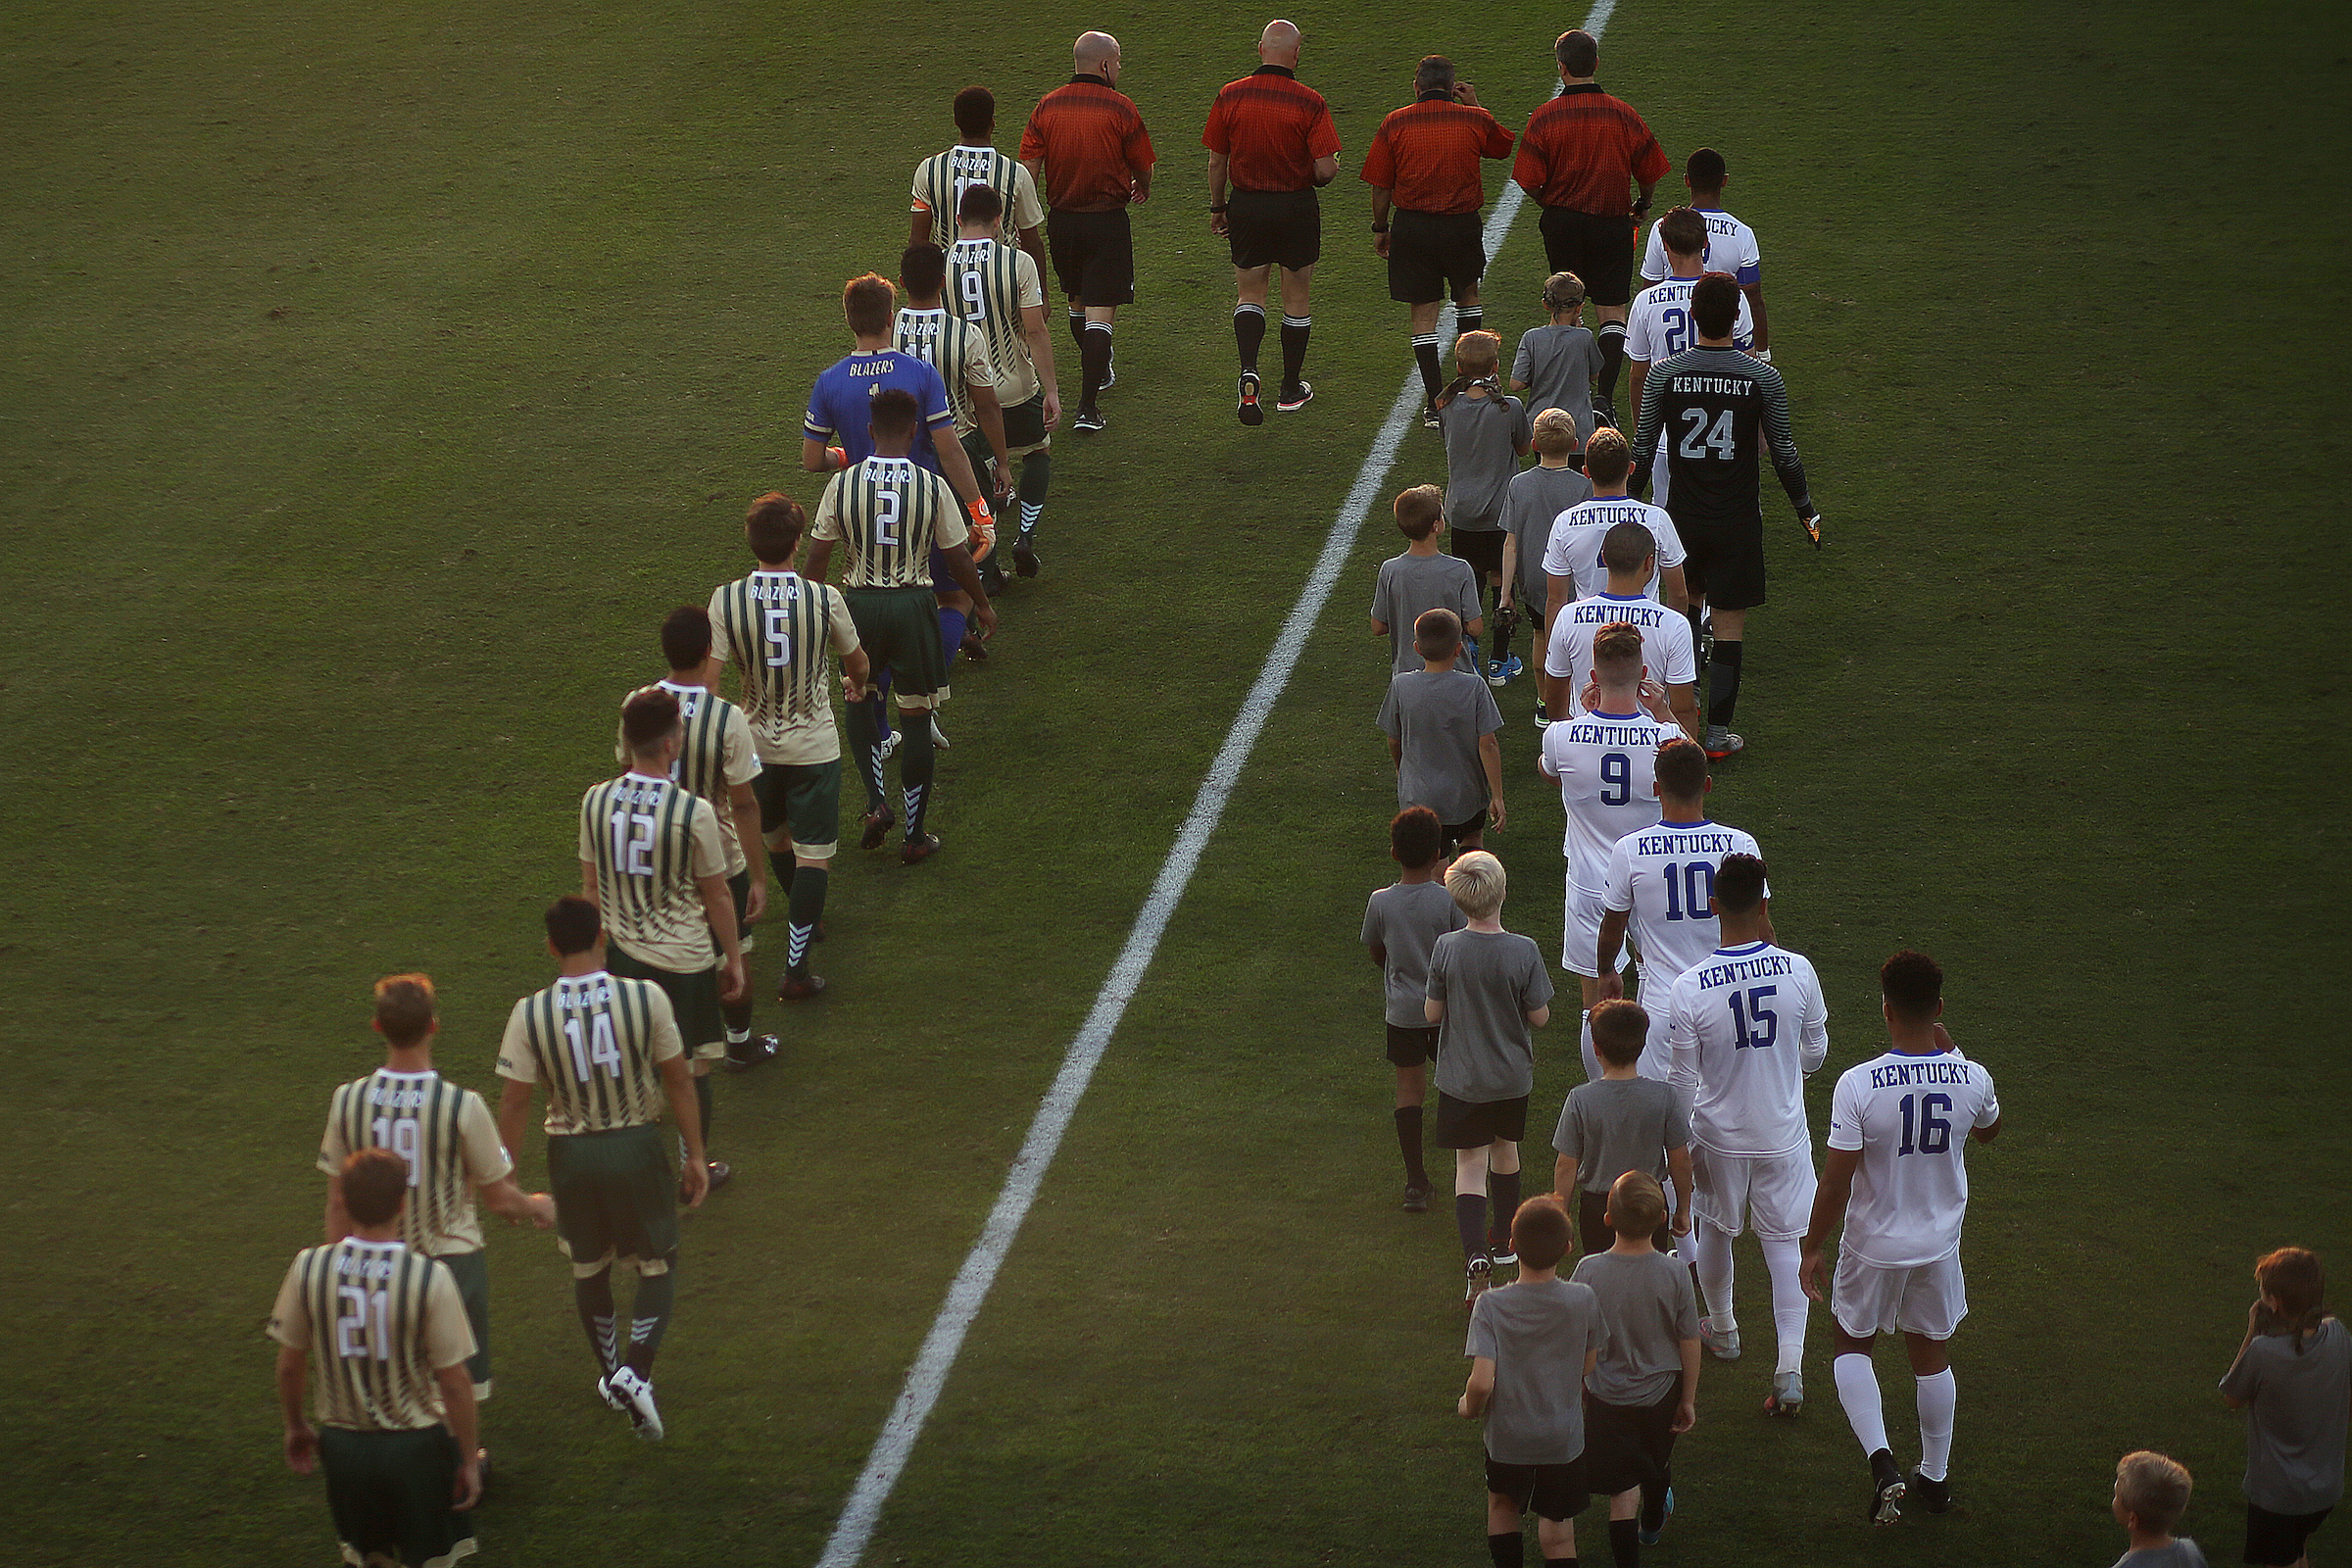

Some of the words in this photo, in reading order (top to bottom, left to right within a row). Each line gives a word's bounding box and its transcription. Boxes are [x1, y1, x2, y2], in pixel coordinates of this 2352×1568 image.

[950, 155, 993, 172] BLAZERS
[1706, 218, 1738, 237] UCKY
[950, 249, 992, 266] BLAZERS
[960, 270, 986, 321] 9
[1648, 284, 1696, 305] KENTU
[897, 319, 942, 338] BLAZERS
[1662, 307, 1698, 355] 2
[849, 359, 896, 377] BLAZERS
[1672, 376, 1753, 397] KENTUCKY
[1680, 408, 1736, 461] 24
[862, 467, 913, 484] BLAZERS
[875, 490, 901, 546] 2
[1568, 507, 1648, 526] KENTUCKY
[749, 584, 802, 601] BLAZERS
[1573, 605, 1665, 628] KENTUCKY
[764, 609, 790, 667] 5
[1569, 724, 1661, 747] KENTUCKY
[1599, 752, 1632, 807] 9
[610, 809, 656, 876] 12
[1638, 833, 1734, 857] KENTUCKY
[1663, 860, 1716, 922] 10
[1698, 955, 1793, 991] KENTUCKY
[1728, 984, 1778, 1051] 15
[564, 1012, 622, 1082] 14
[1870, 1062, 1971, 1089] KENTUCKY
[1898, 1092, 1953, 1157] 16
[337, 1285, 389, 1360] 21
